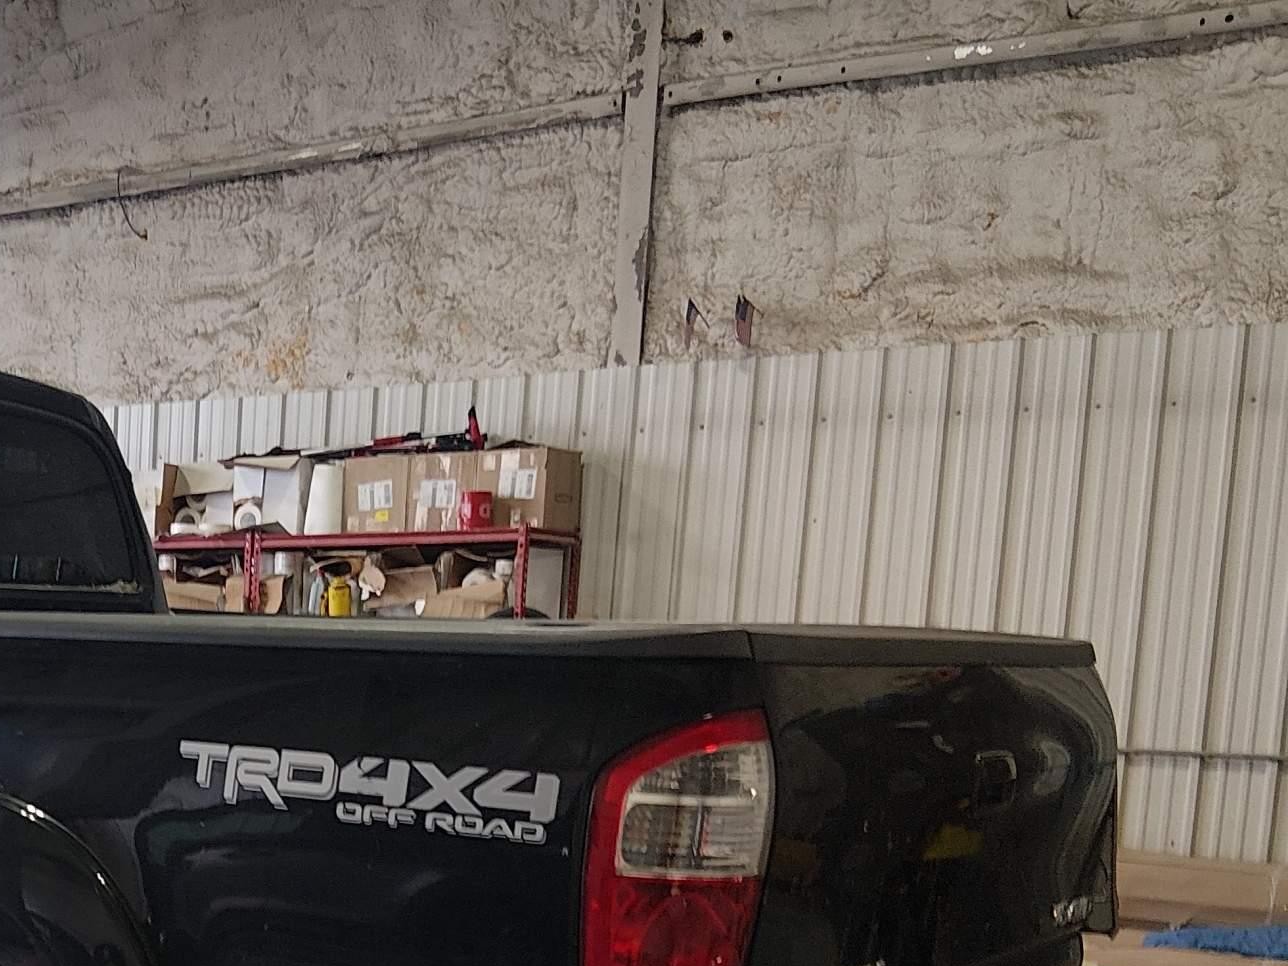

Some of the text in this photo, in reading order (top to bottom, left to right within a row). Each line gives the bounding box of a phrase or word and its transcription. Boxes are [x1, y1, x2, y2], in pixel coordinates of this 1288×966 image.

[179, 739, 340, 811] TRD
[335, 801, 547, 845] OFF ROAD
